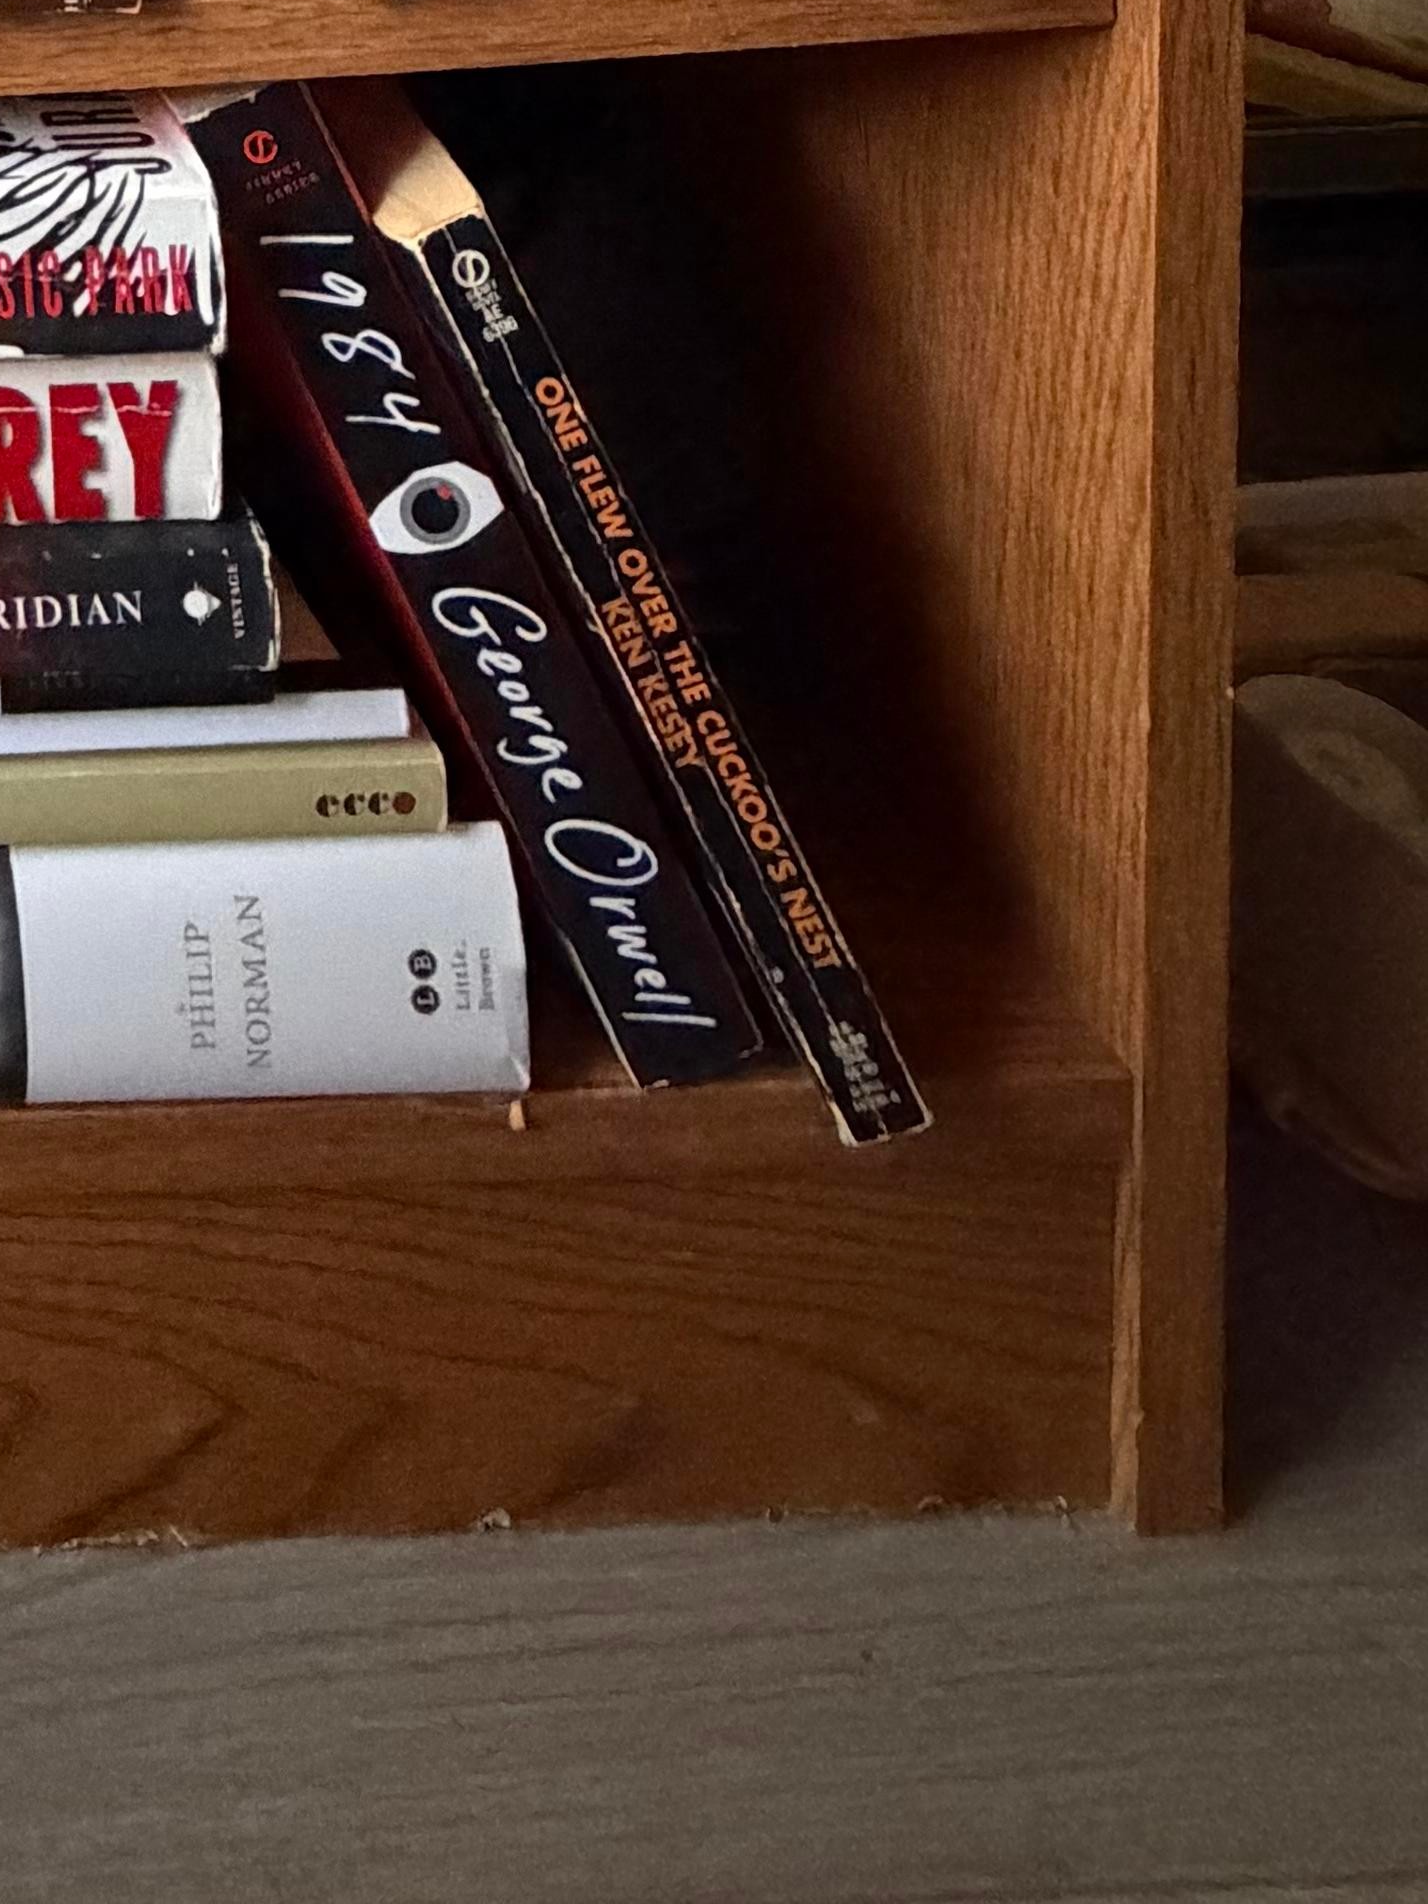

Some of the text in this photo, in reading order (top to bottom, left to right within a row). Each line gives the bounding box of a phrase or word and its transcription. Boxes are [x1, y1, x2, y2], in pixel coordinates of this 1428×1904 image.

[259, 232, 440, 437] 1984
[432, 586, 719, 1032] George Orwell
